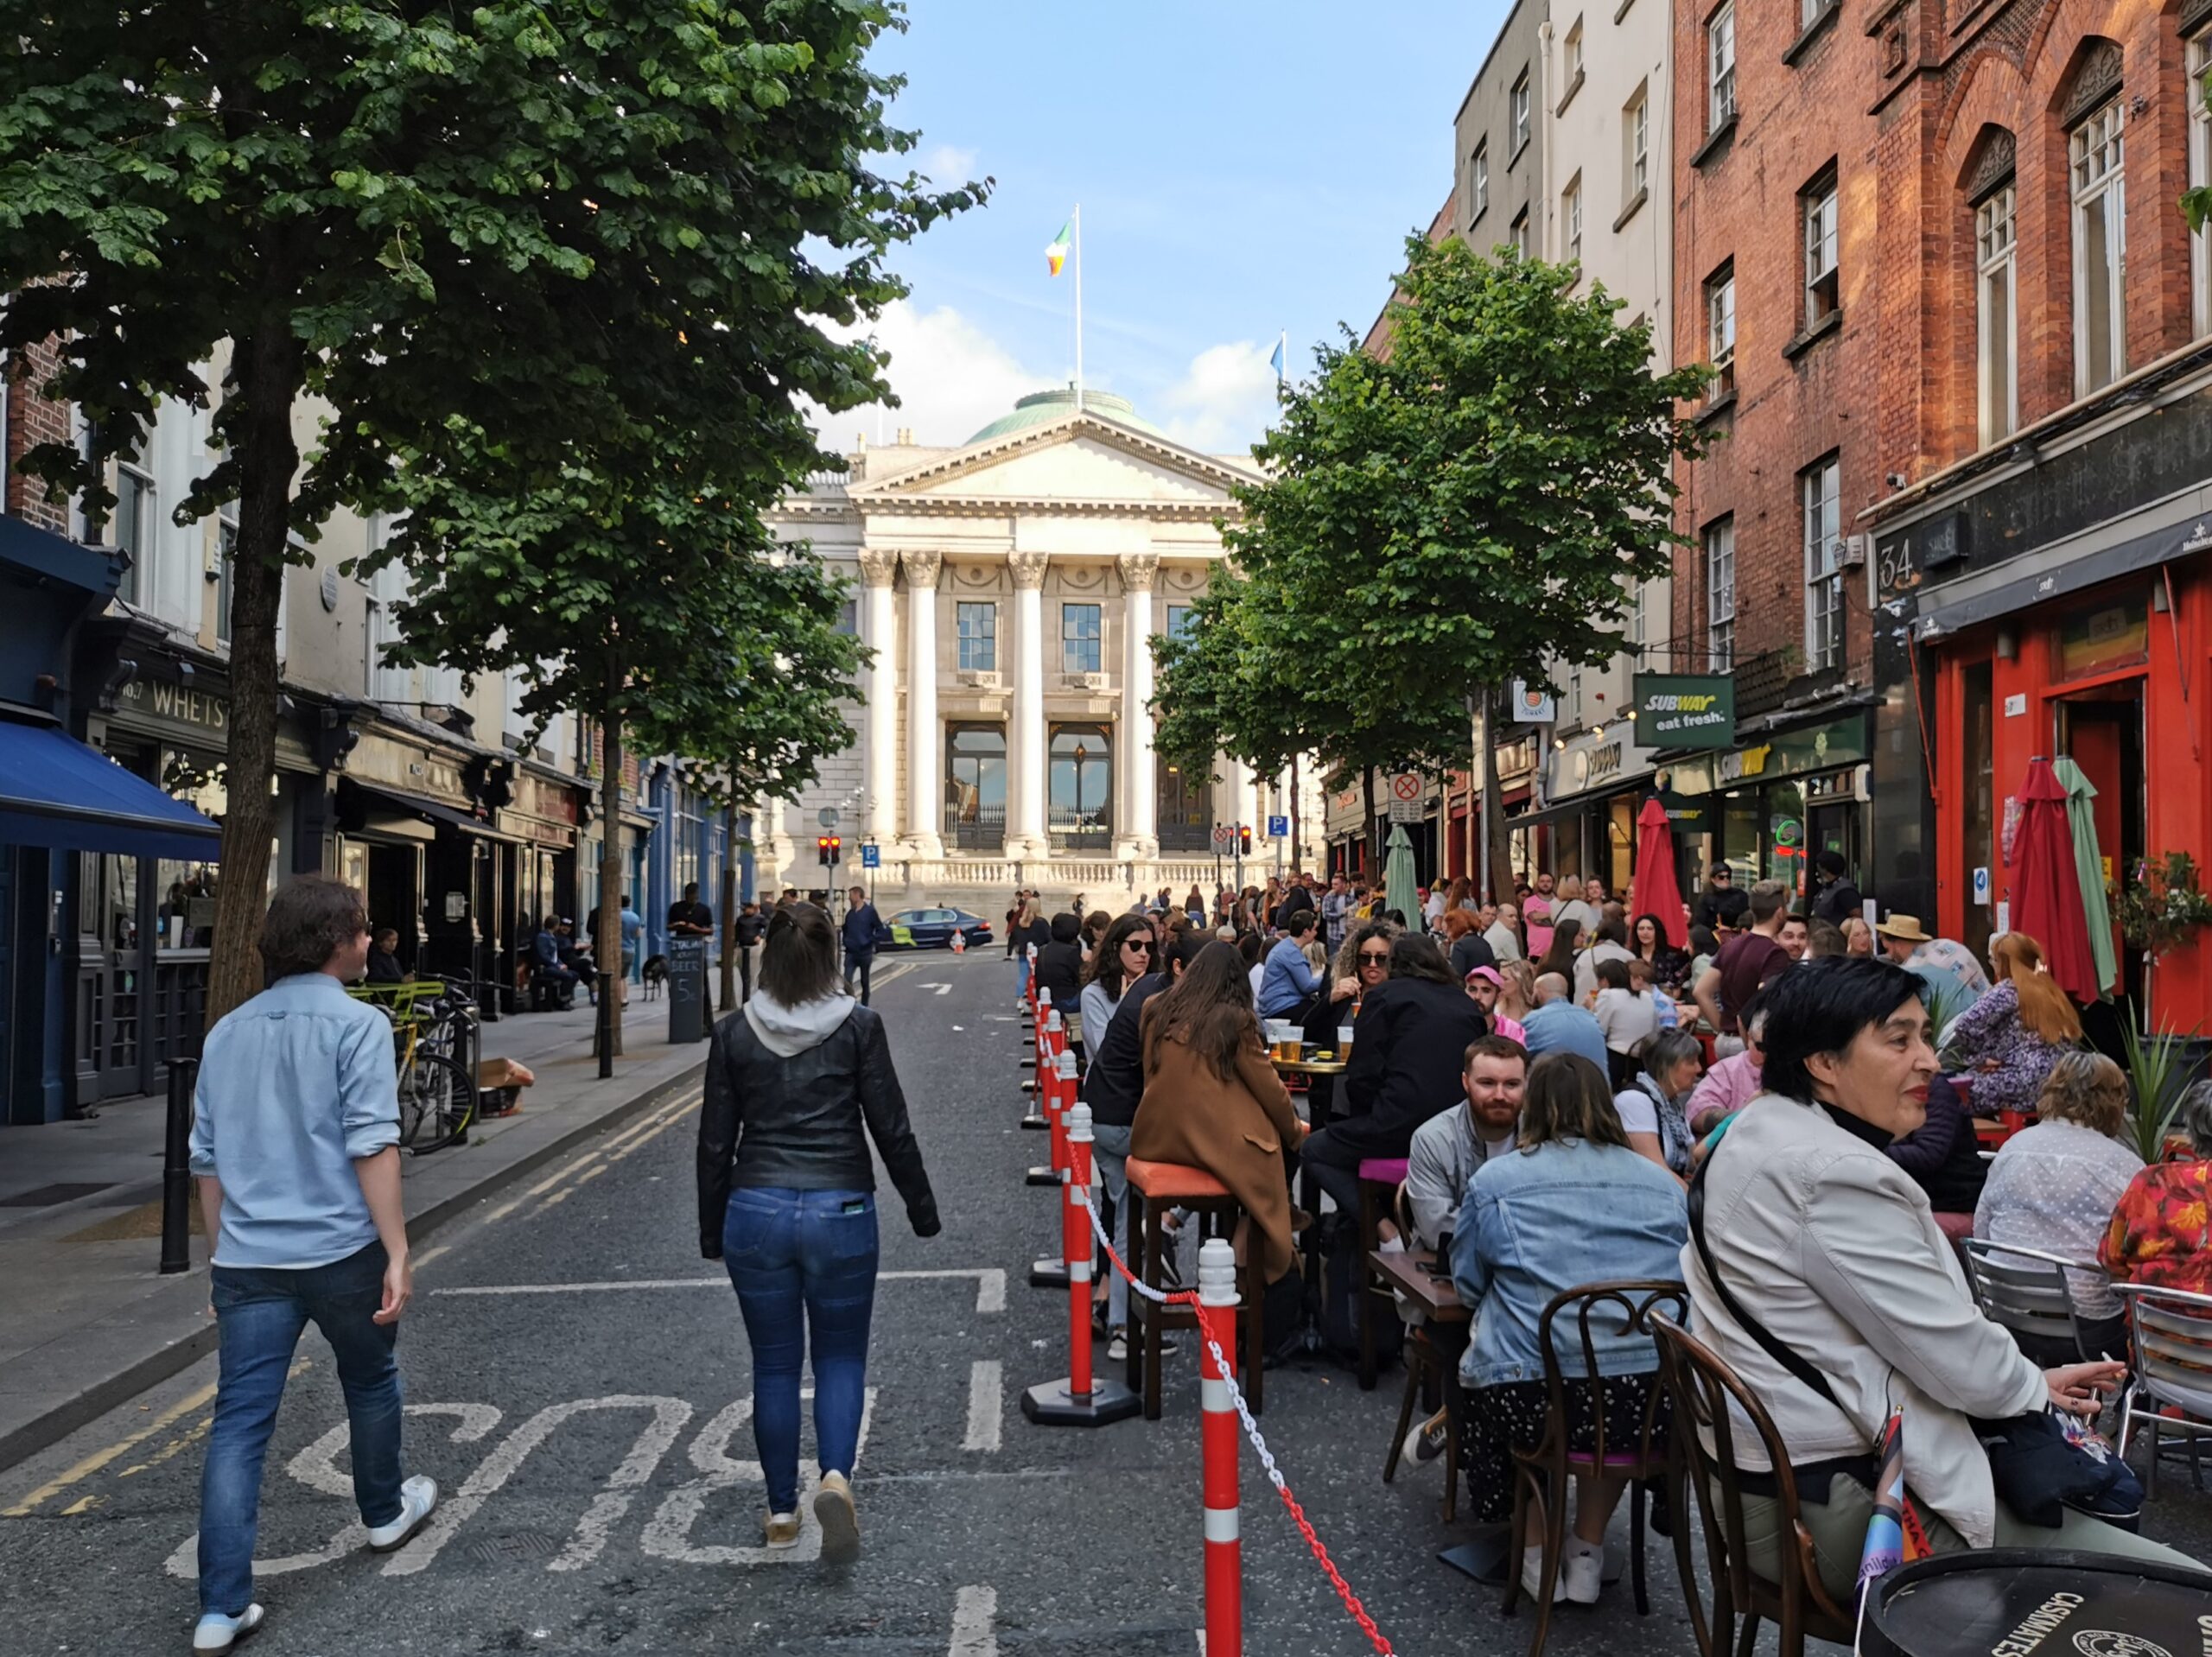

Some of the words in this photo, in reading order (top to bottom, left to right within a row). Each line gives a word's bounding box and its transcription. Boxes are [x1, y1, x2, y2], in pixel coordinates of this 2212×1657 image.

[1880, 537, 1913, 587] 34
[152, 679, 230, 727] WHETS
[1644, 695, 1716, 711] SUBWAY
[1656, 718, 1680, 731] eat
[1719, 742, 1771, 782] SUBWAY
[1273, 816, 1283, 829] P
[867, 847, 876, 860] P
[671, 960, 700, 972] BEER
[1991, 1591, 2085, 1657] CASKMATES
